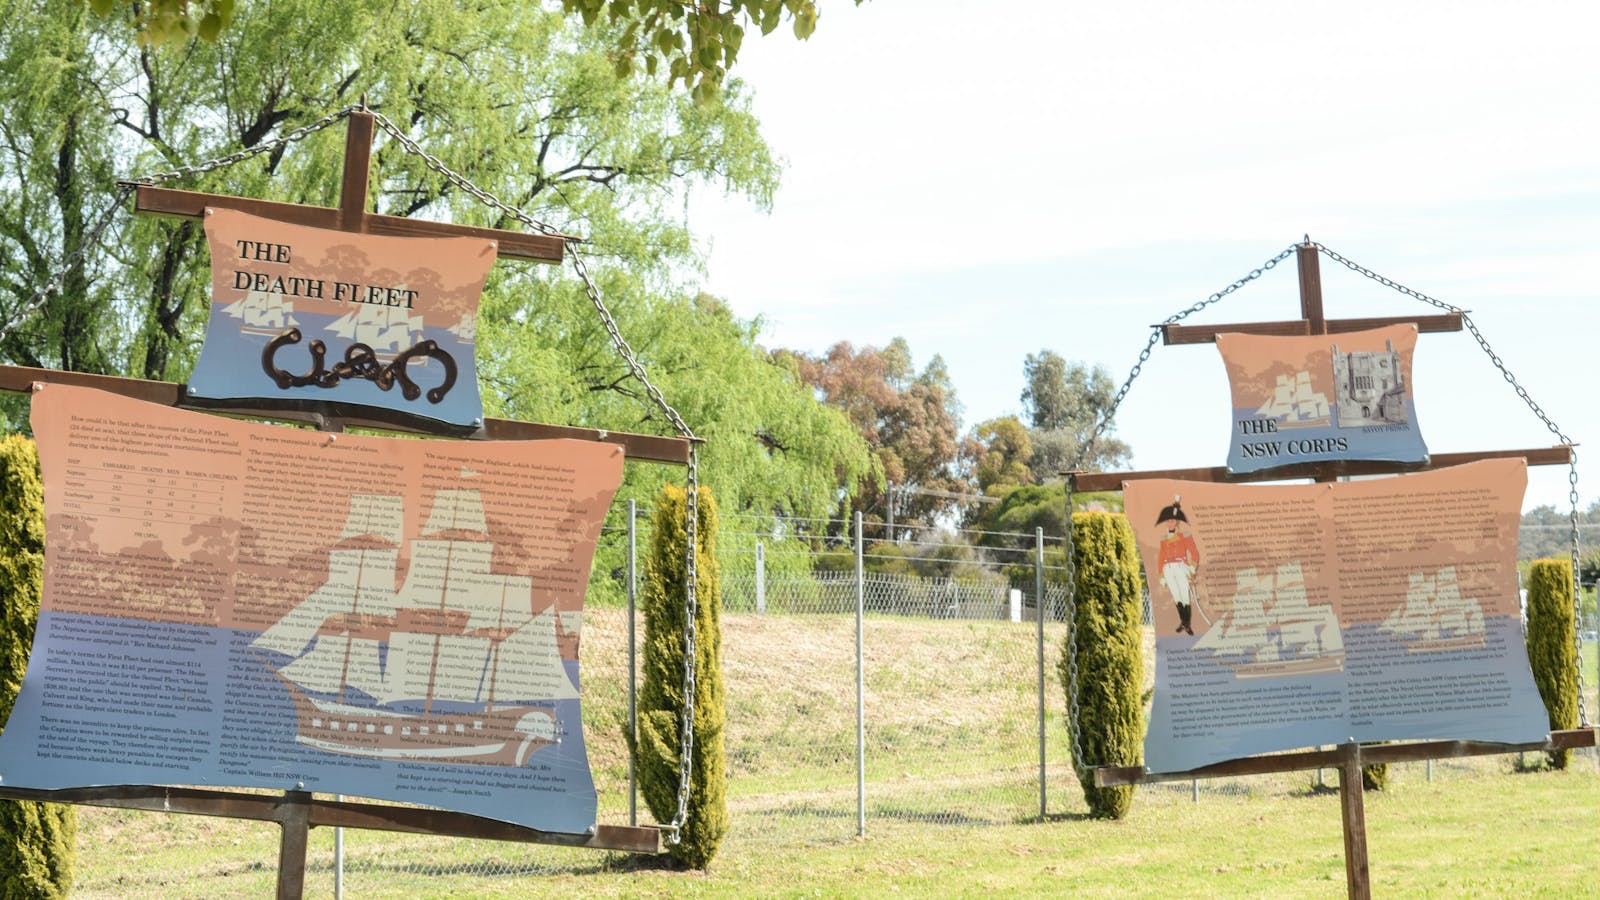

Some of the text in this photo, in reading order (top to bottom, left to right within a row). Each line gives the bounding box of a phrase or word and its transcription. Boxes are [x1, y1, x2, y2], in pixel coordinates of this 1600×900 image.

[236, 240, 291, 264] THE
[232, 271, 418, 309] DEATH FLEET
[1239, 419, 1277, 435] THE
[1241, 438, 1348, 458] NSW CORPS
